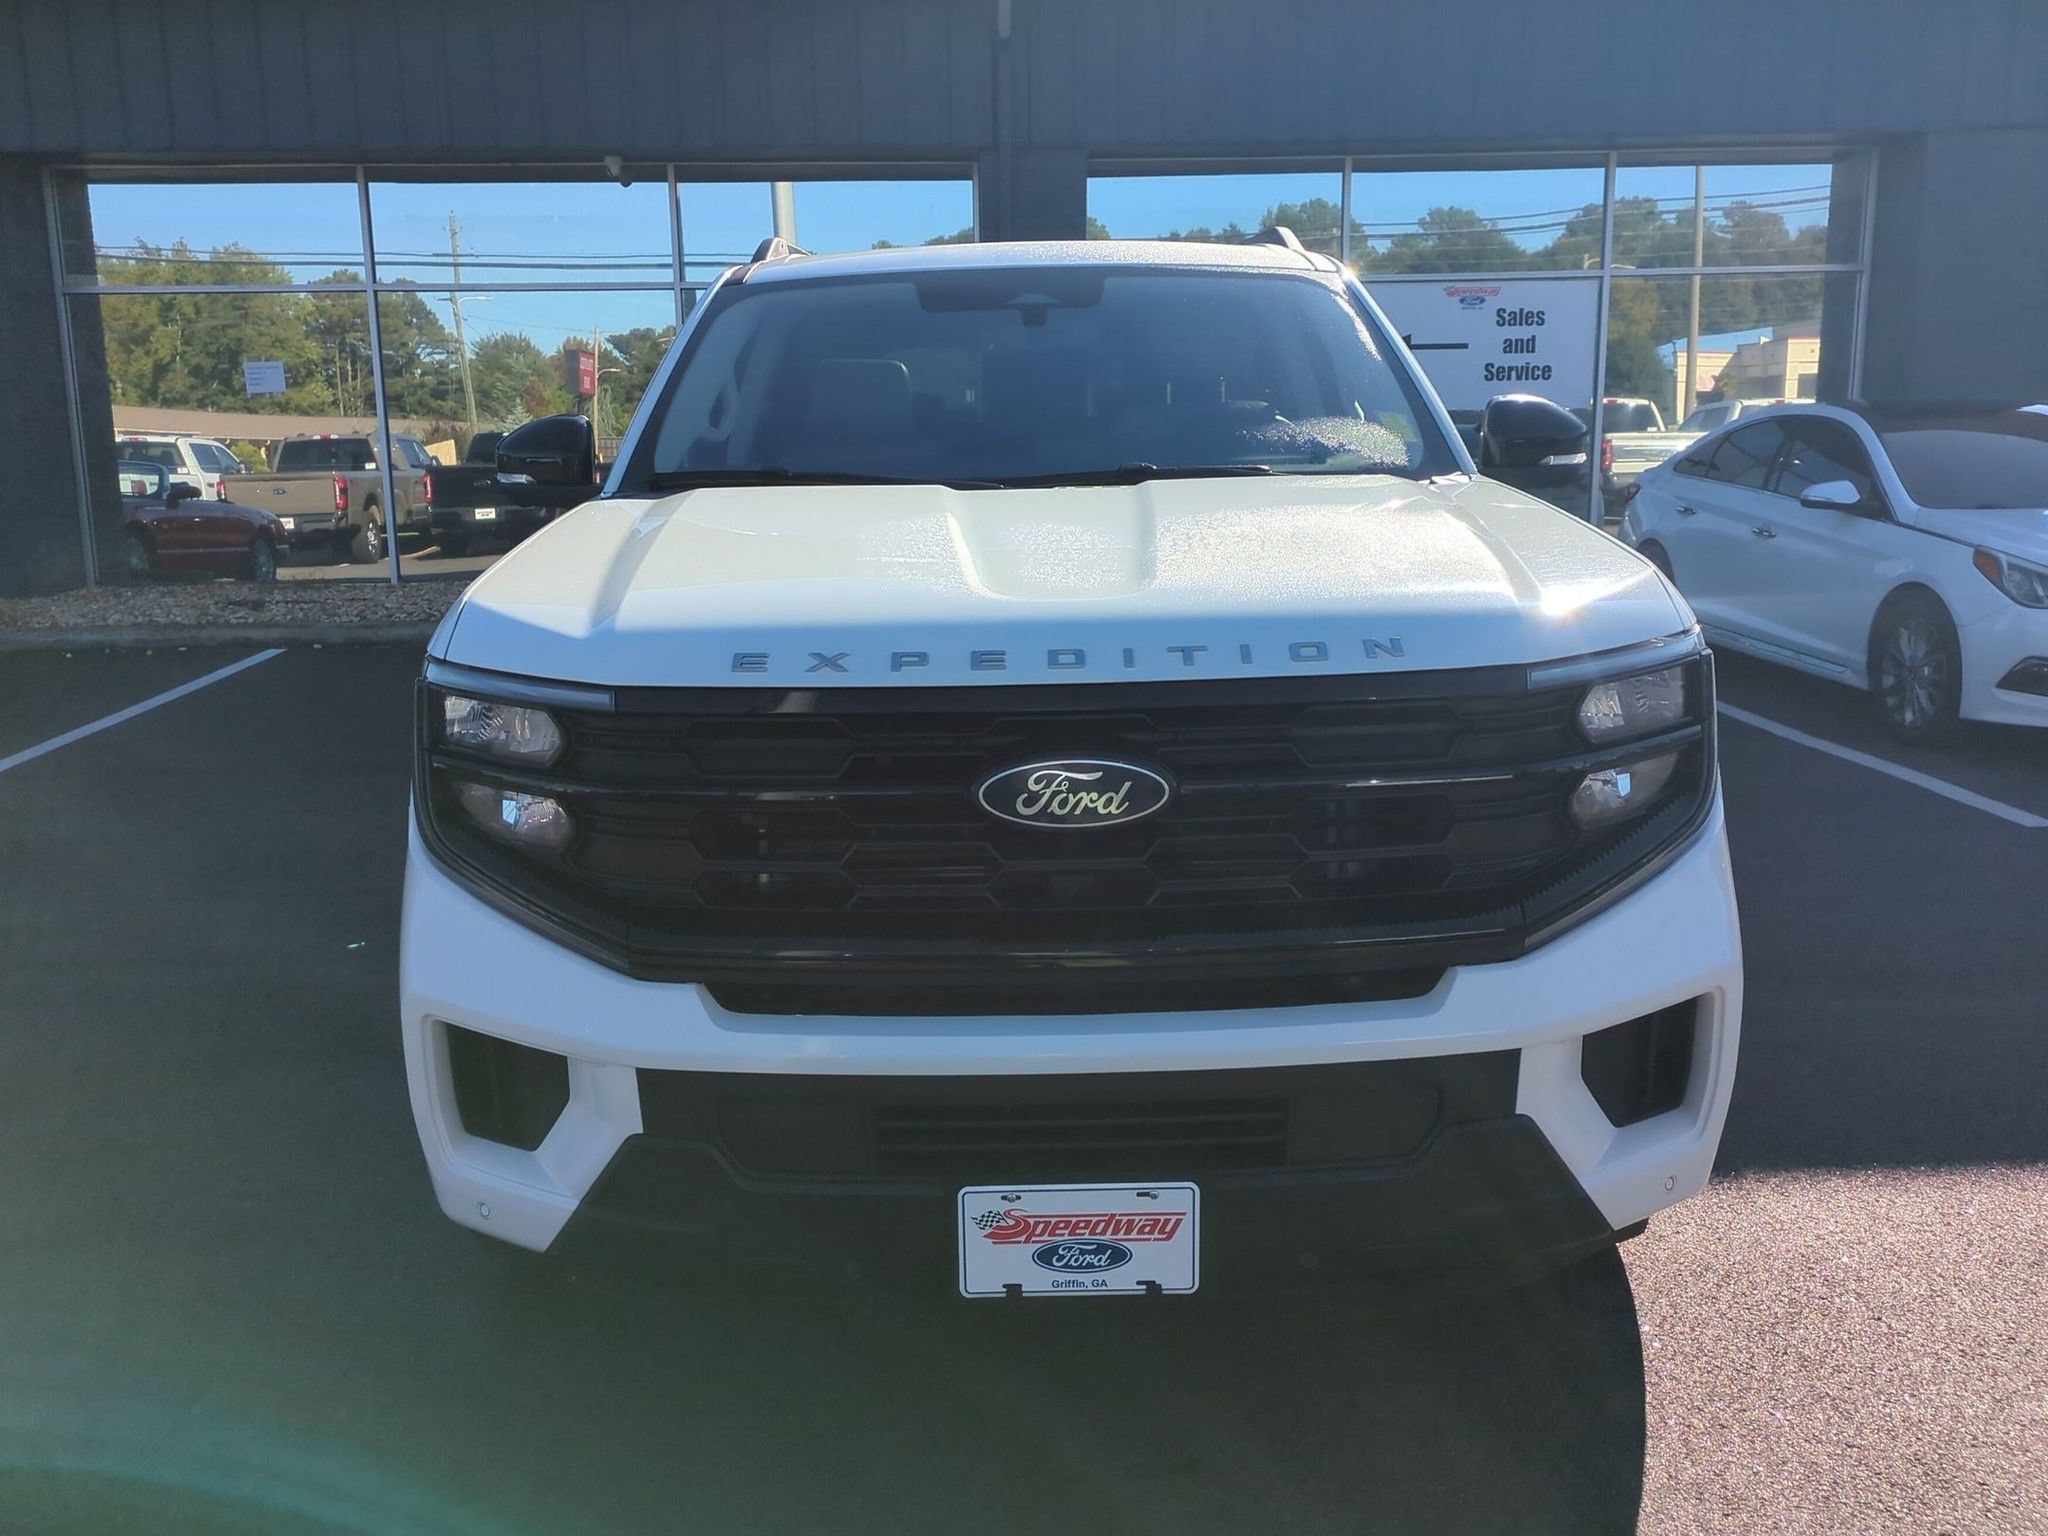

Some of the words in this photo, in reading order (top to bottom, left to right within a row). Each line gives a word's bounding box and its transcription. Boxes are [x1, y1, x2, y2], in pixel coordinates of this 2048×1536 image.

[1496, 307, 1546, 327] Sales
[1502, 335, 1536, 354] and
[1484, 362, 1552, 382] Service
[731, 635, 1405, 673] EXPEDITION
[1016, 770, 1132, 815] Ford
[983, 1209, 1187, 1243] Speedway
[1052, 1244, 1111, 1267] Ford
[1051, 1279, 1088, 1289] Griffin,
[1091, 1278, 1108, 1288] GA
